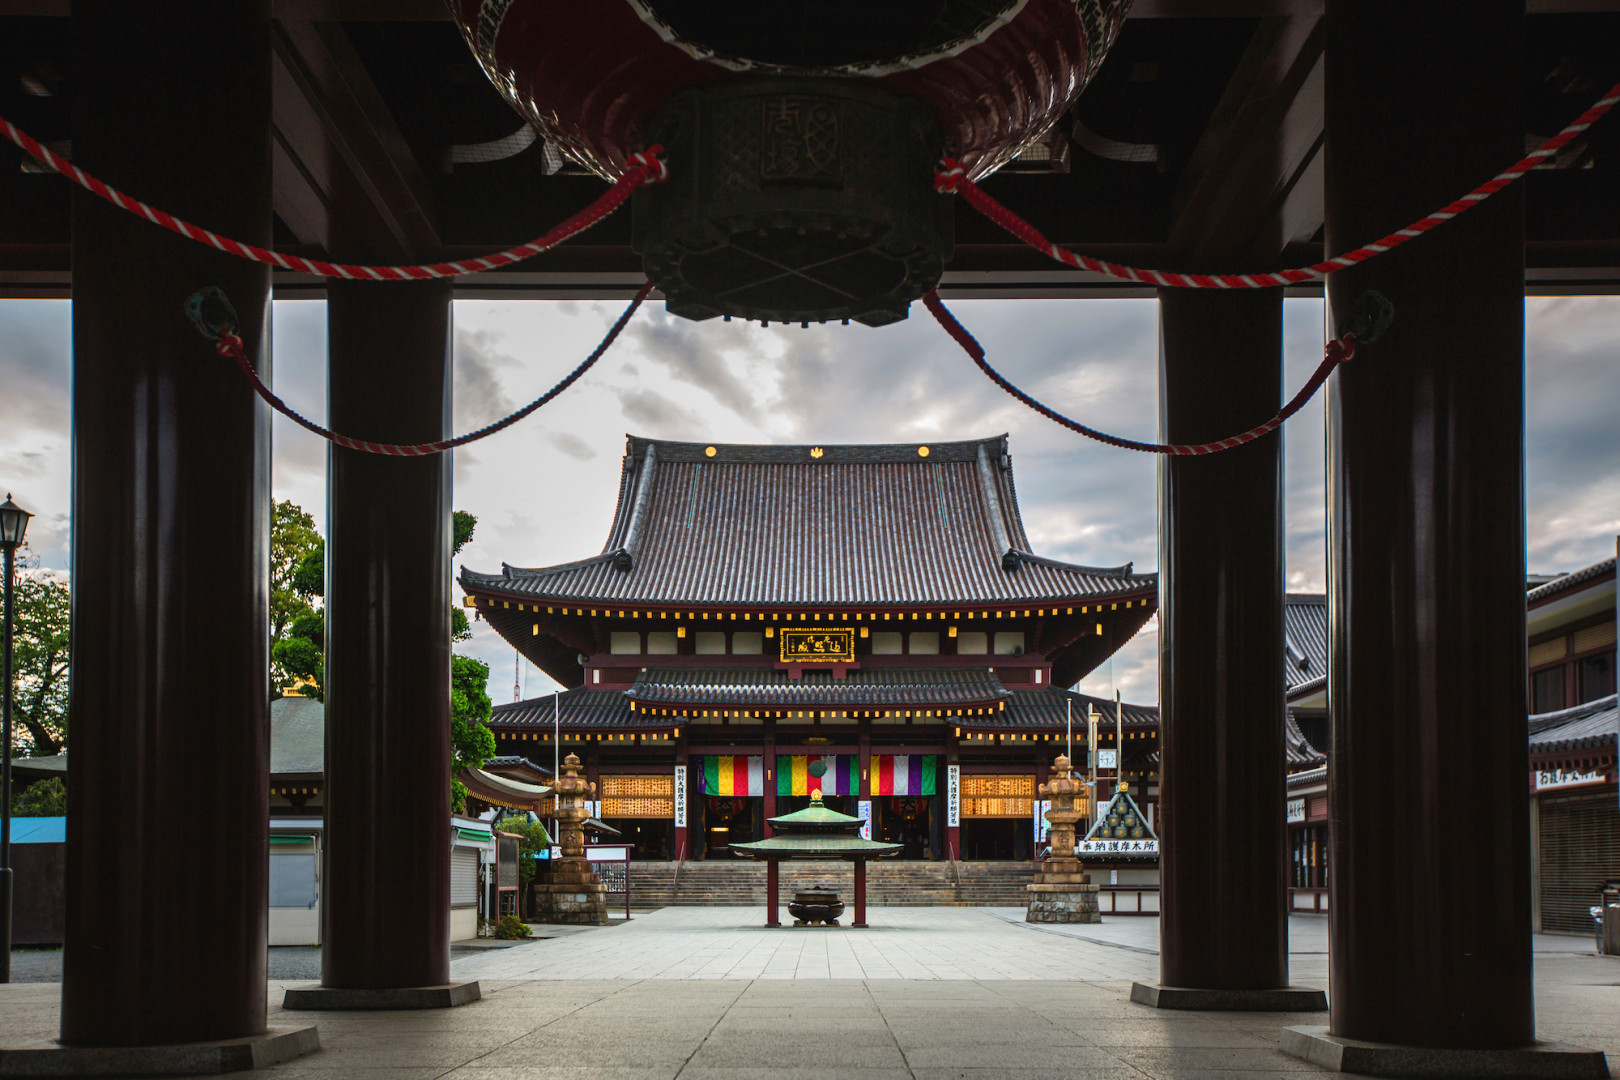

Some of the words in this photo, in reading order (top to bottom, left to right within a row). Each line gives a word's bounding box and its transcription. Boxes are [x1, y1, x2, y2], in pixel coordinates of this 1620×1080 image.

[1082, 841, 1155, 852] 奉納護摩木所
